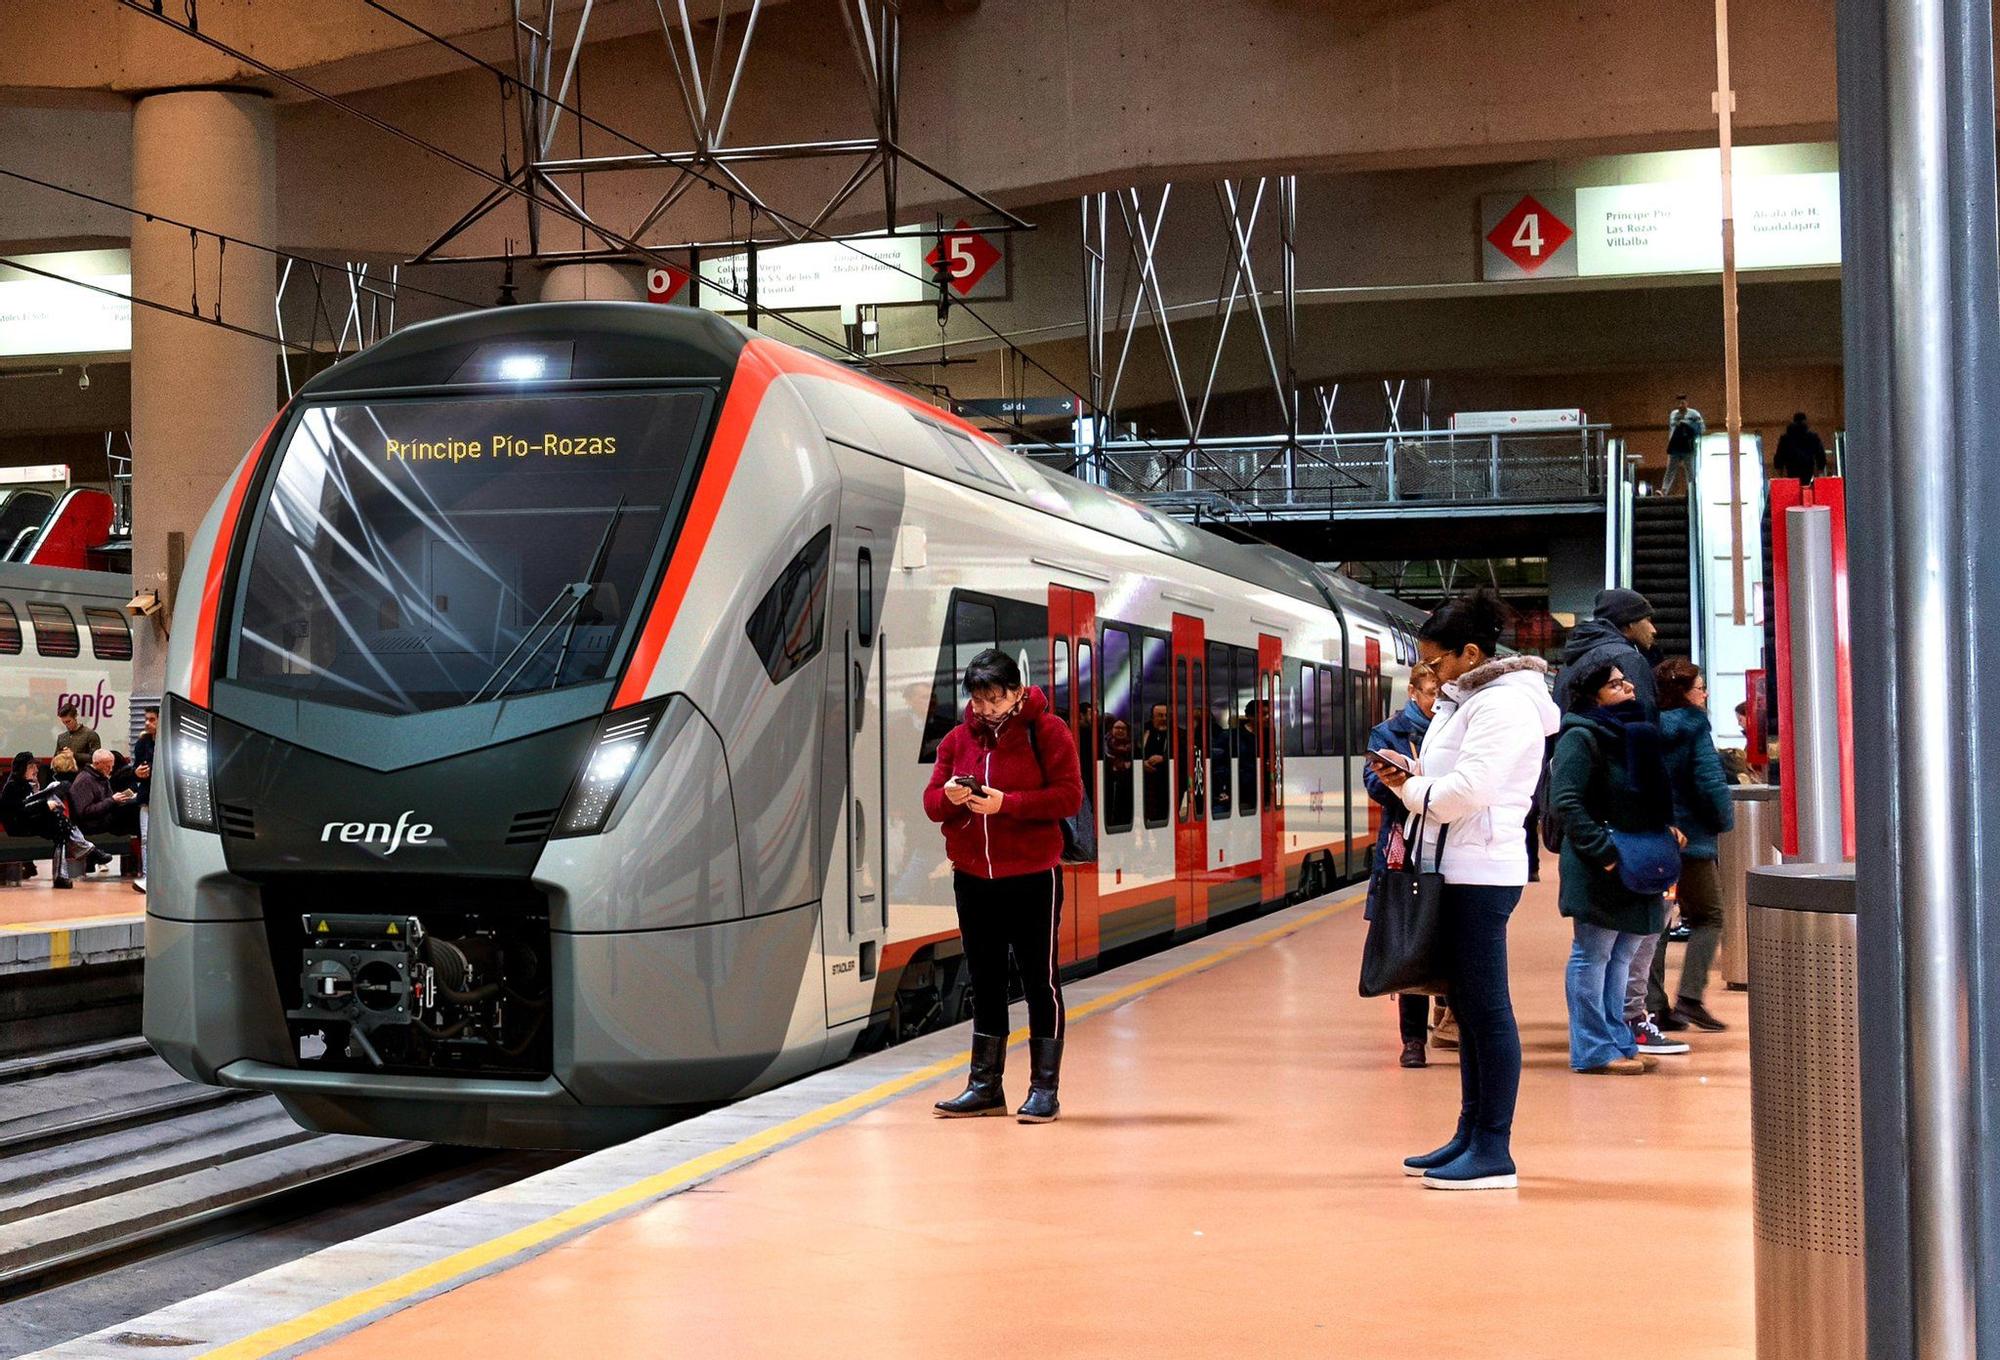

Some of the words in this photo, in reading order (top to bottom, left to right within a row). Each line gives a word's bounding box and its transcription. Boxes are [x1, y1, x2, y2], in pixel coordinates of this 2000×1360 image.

[1511, 213, 1545, 256] 4
[1606, 225, 1624, 234] Las
[1606, 236, 1648, 247] Villalba
[950, 236, 976, 278] 5
[386, 437, 481, 464] Príncipe
[320, 810, 433, 855] renfe
